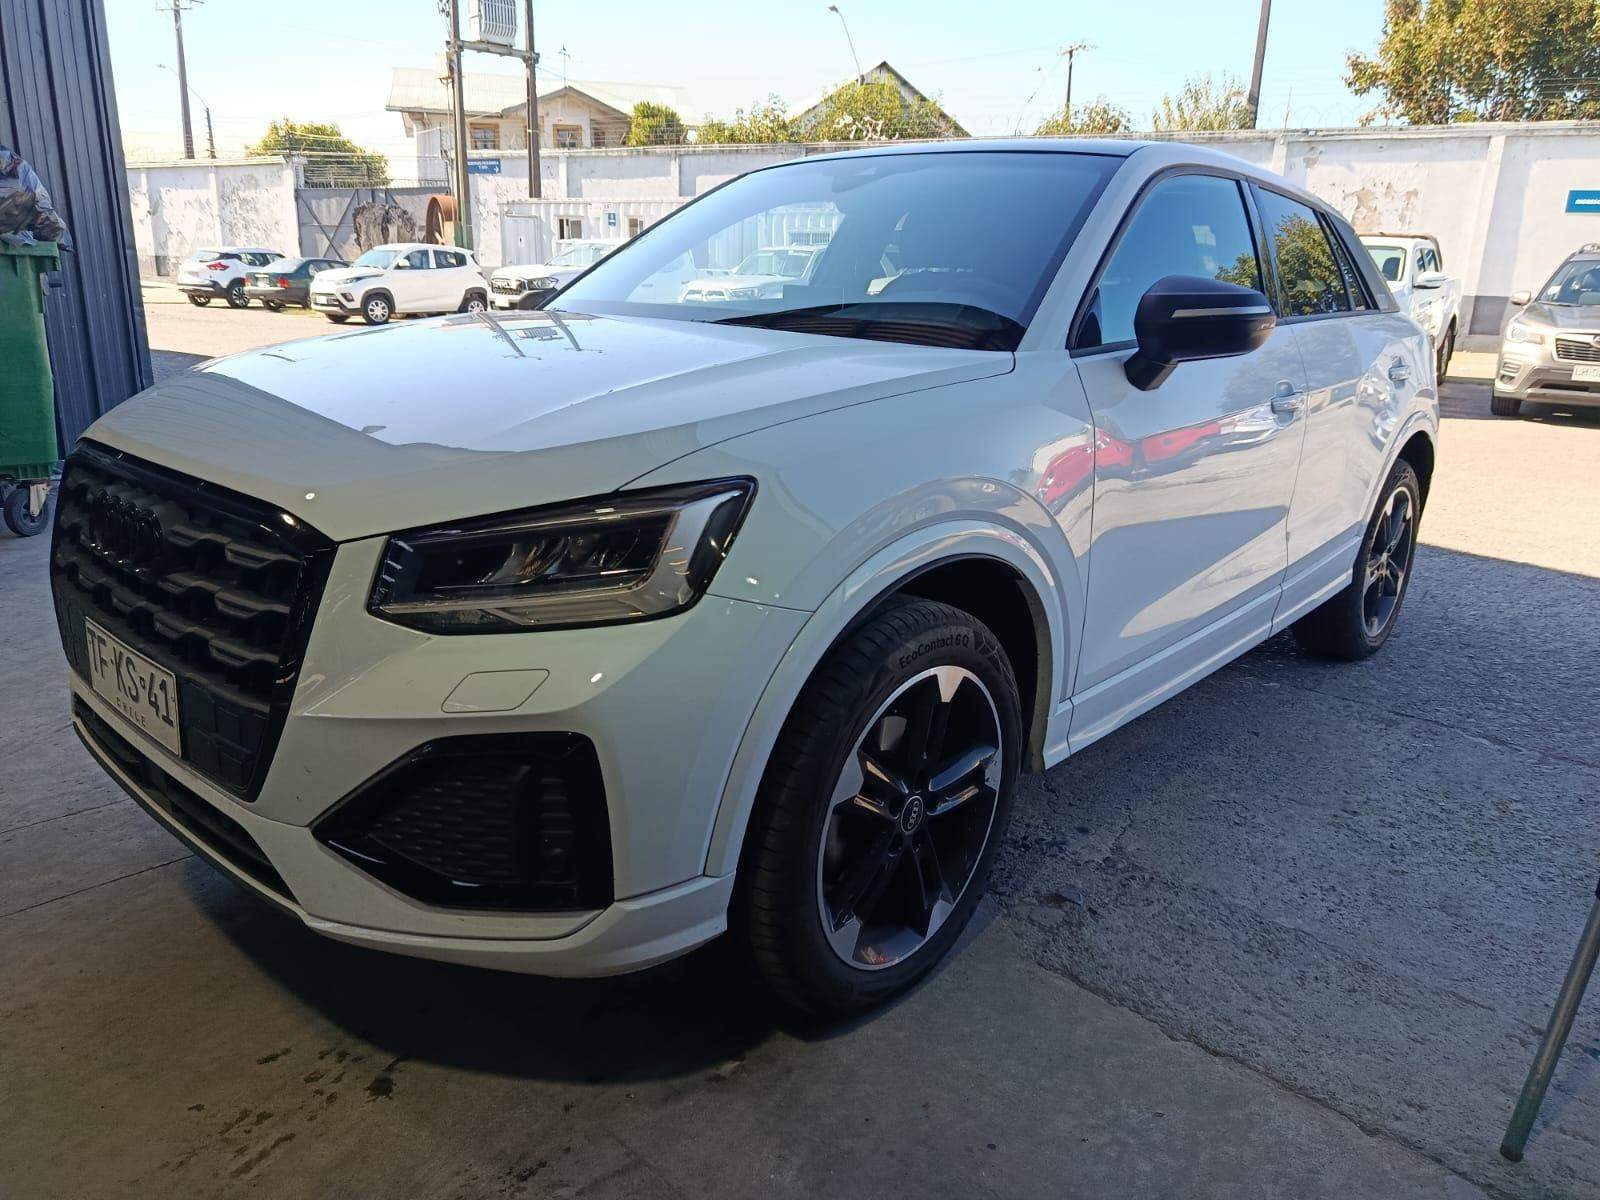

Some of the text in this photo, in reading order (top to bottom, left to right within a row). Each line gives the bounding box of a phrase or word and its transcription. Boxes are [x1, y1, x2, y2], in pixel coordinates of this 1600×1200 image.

[899, 633, 970, 669] EcoContact 6 Q
[116, 696, 146, 728] CHILE
